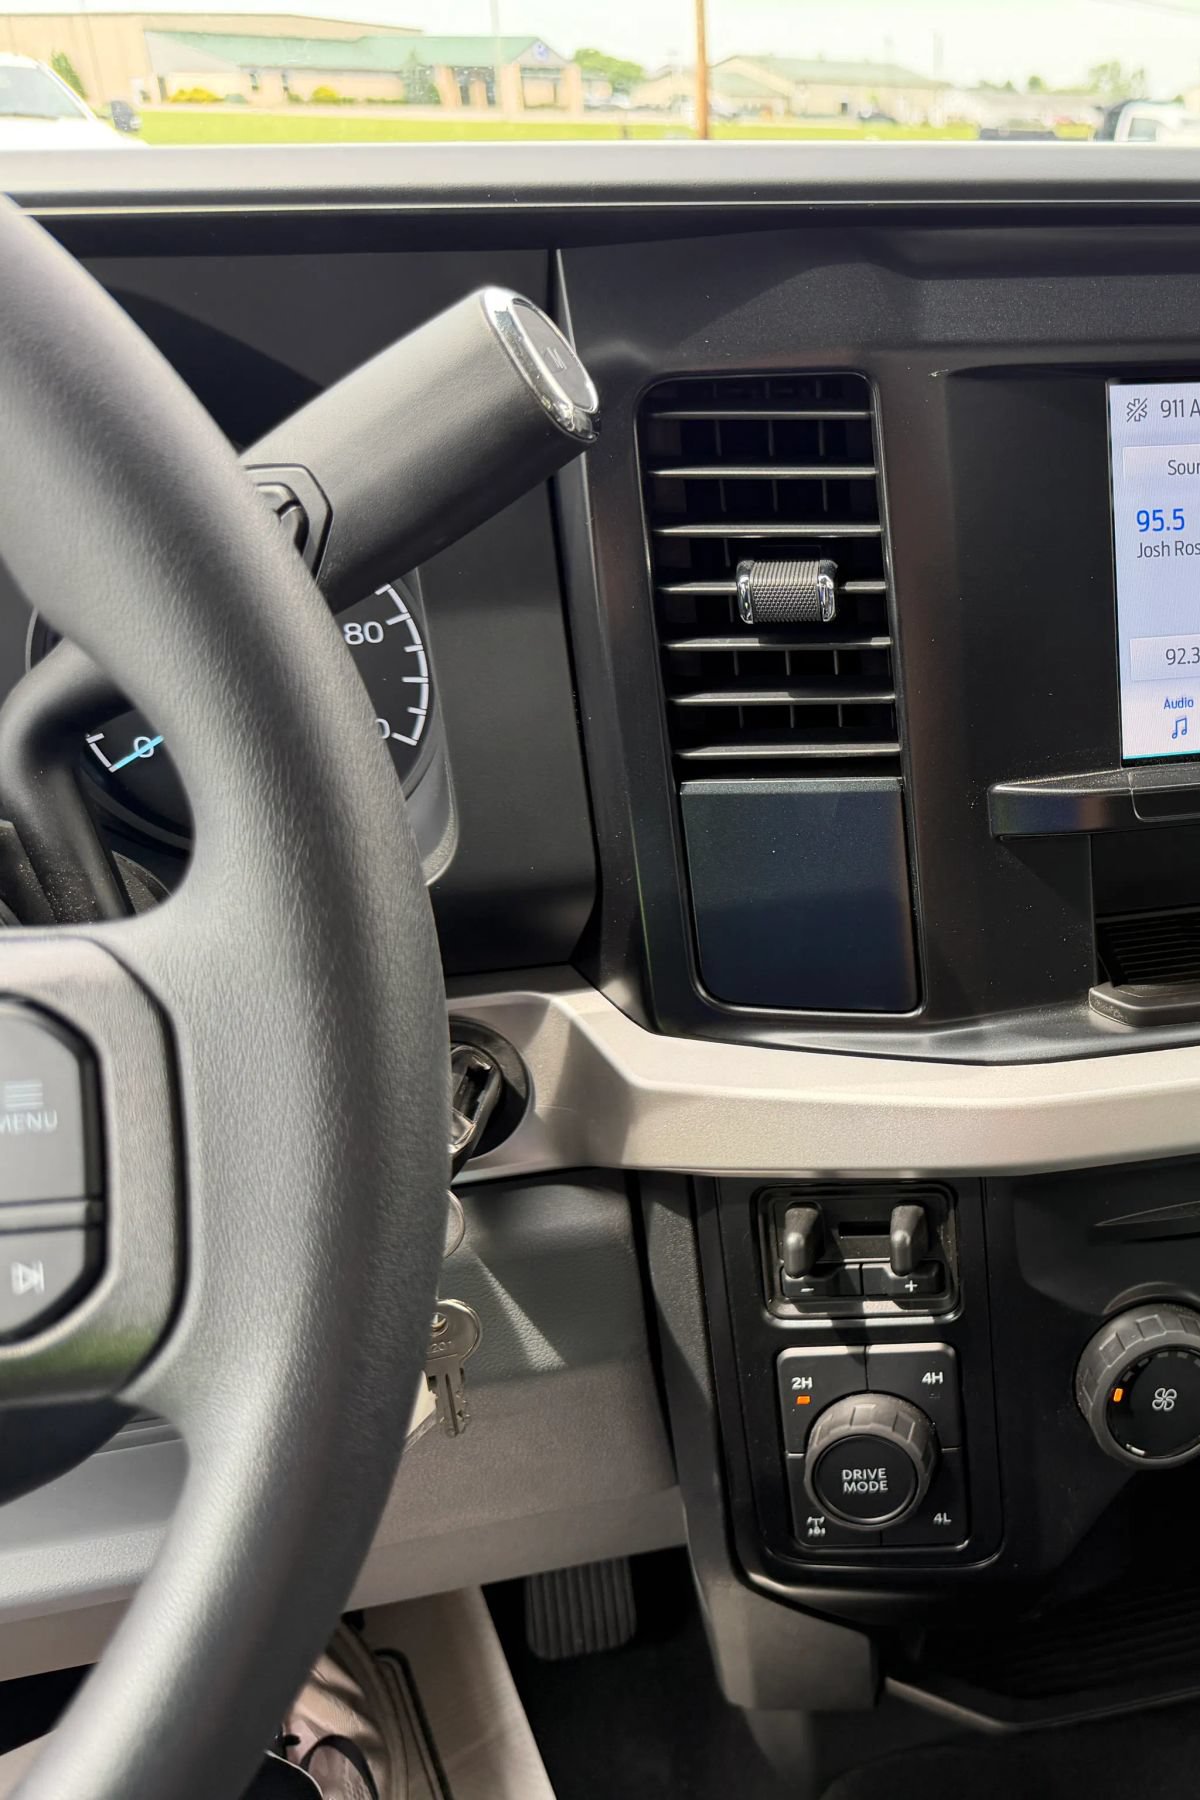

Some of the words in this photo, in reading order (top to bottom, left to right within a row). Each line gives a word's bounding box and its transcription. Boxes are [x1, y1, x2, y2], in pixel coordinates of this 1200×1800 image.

[1160, 398, 1185, 418] 911
[1136, 507, 1186, 533] 95.5
[1136, 541, 1171, 559] Josh
[343, 621, 385, 645] 80
[1163, 696, 1195, 711] Audio
[791, 1376, 813, 1390] 2H
[921, 1372, 944, 1385] 4H
[842, 1467, 887, 1480] DRIVE
[843, 1480, 888, 1493] MODE
[933, 1512, 952, 1525] 4L
